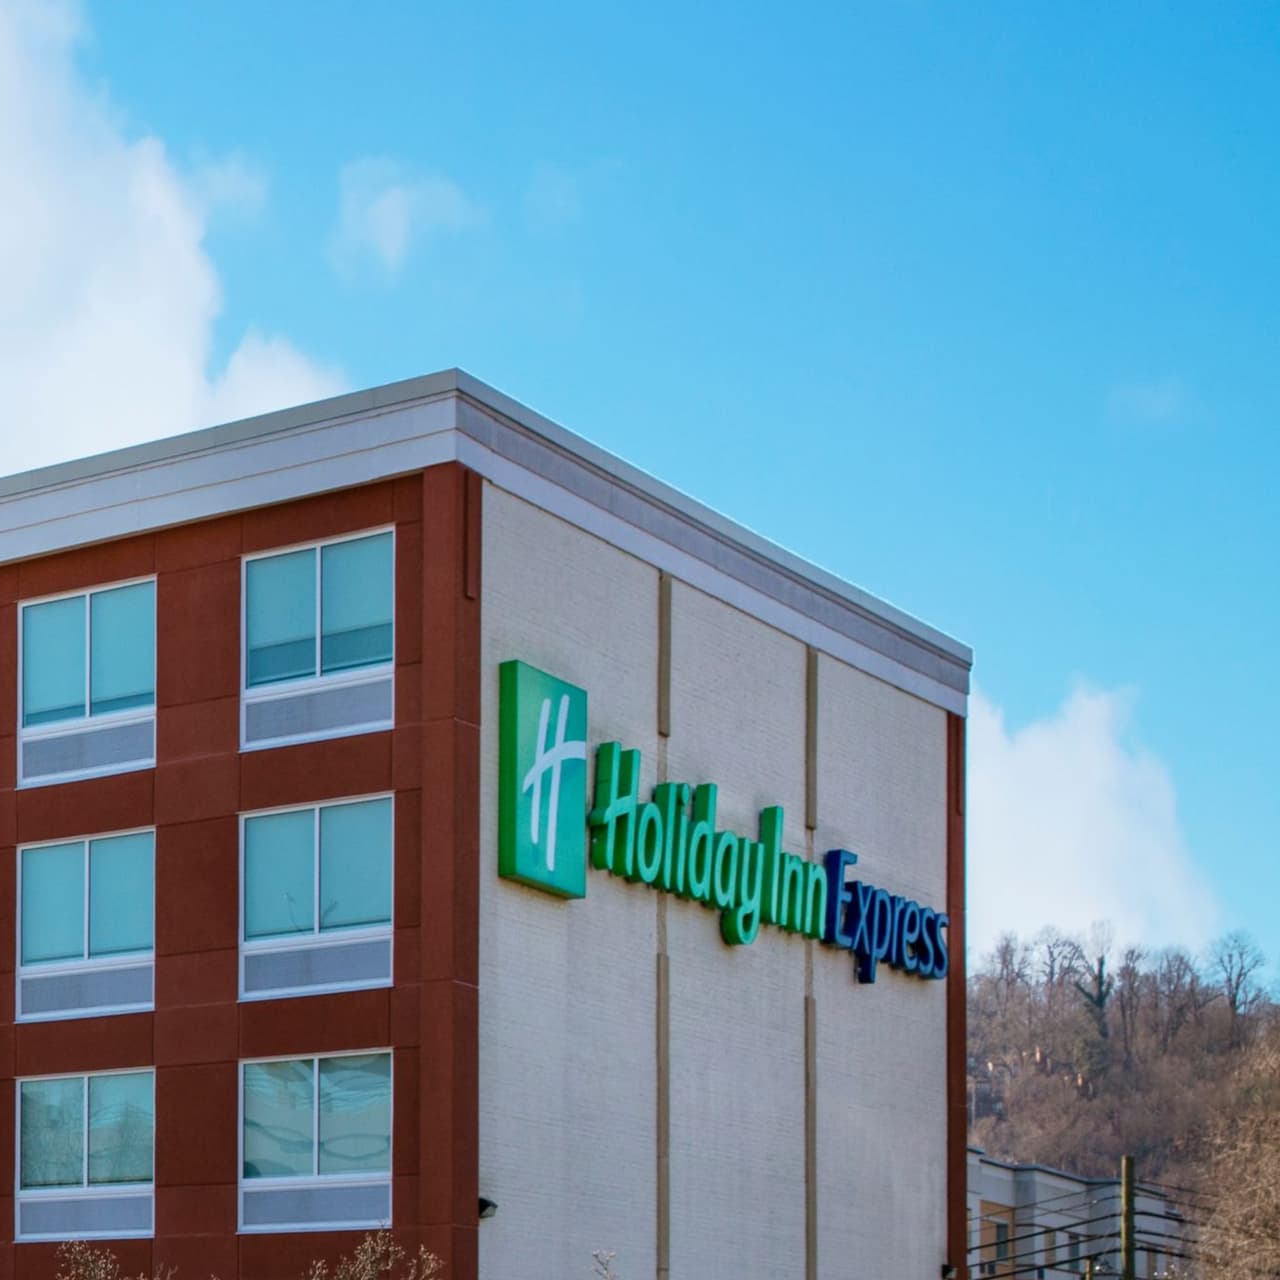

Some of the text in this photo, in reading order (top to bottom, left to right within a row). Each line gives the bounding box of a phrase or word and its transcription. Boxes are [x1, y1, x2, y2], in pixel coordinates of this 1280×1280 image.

[522, 693, 586, 872] H
[590, 741, 948, 984] Holiday Inn Express
